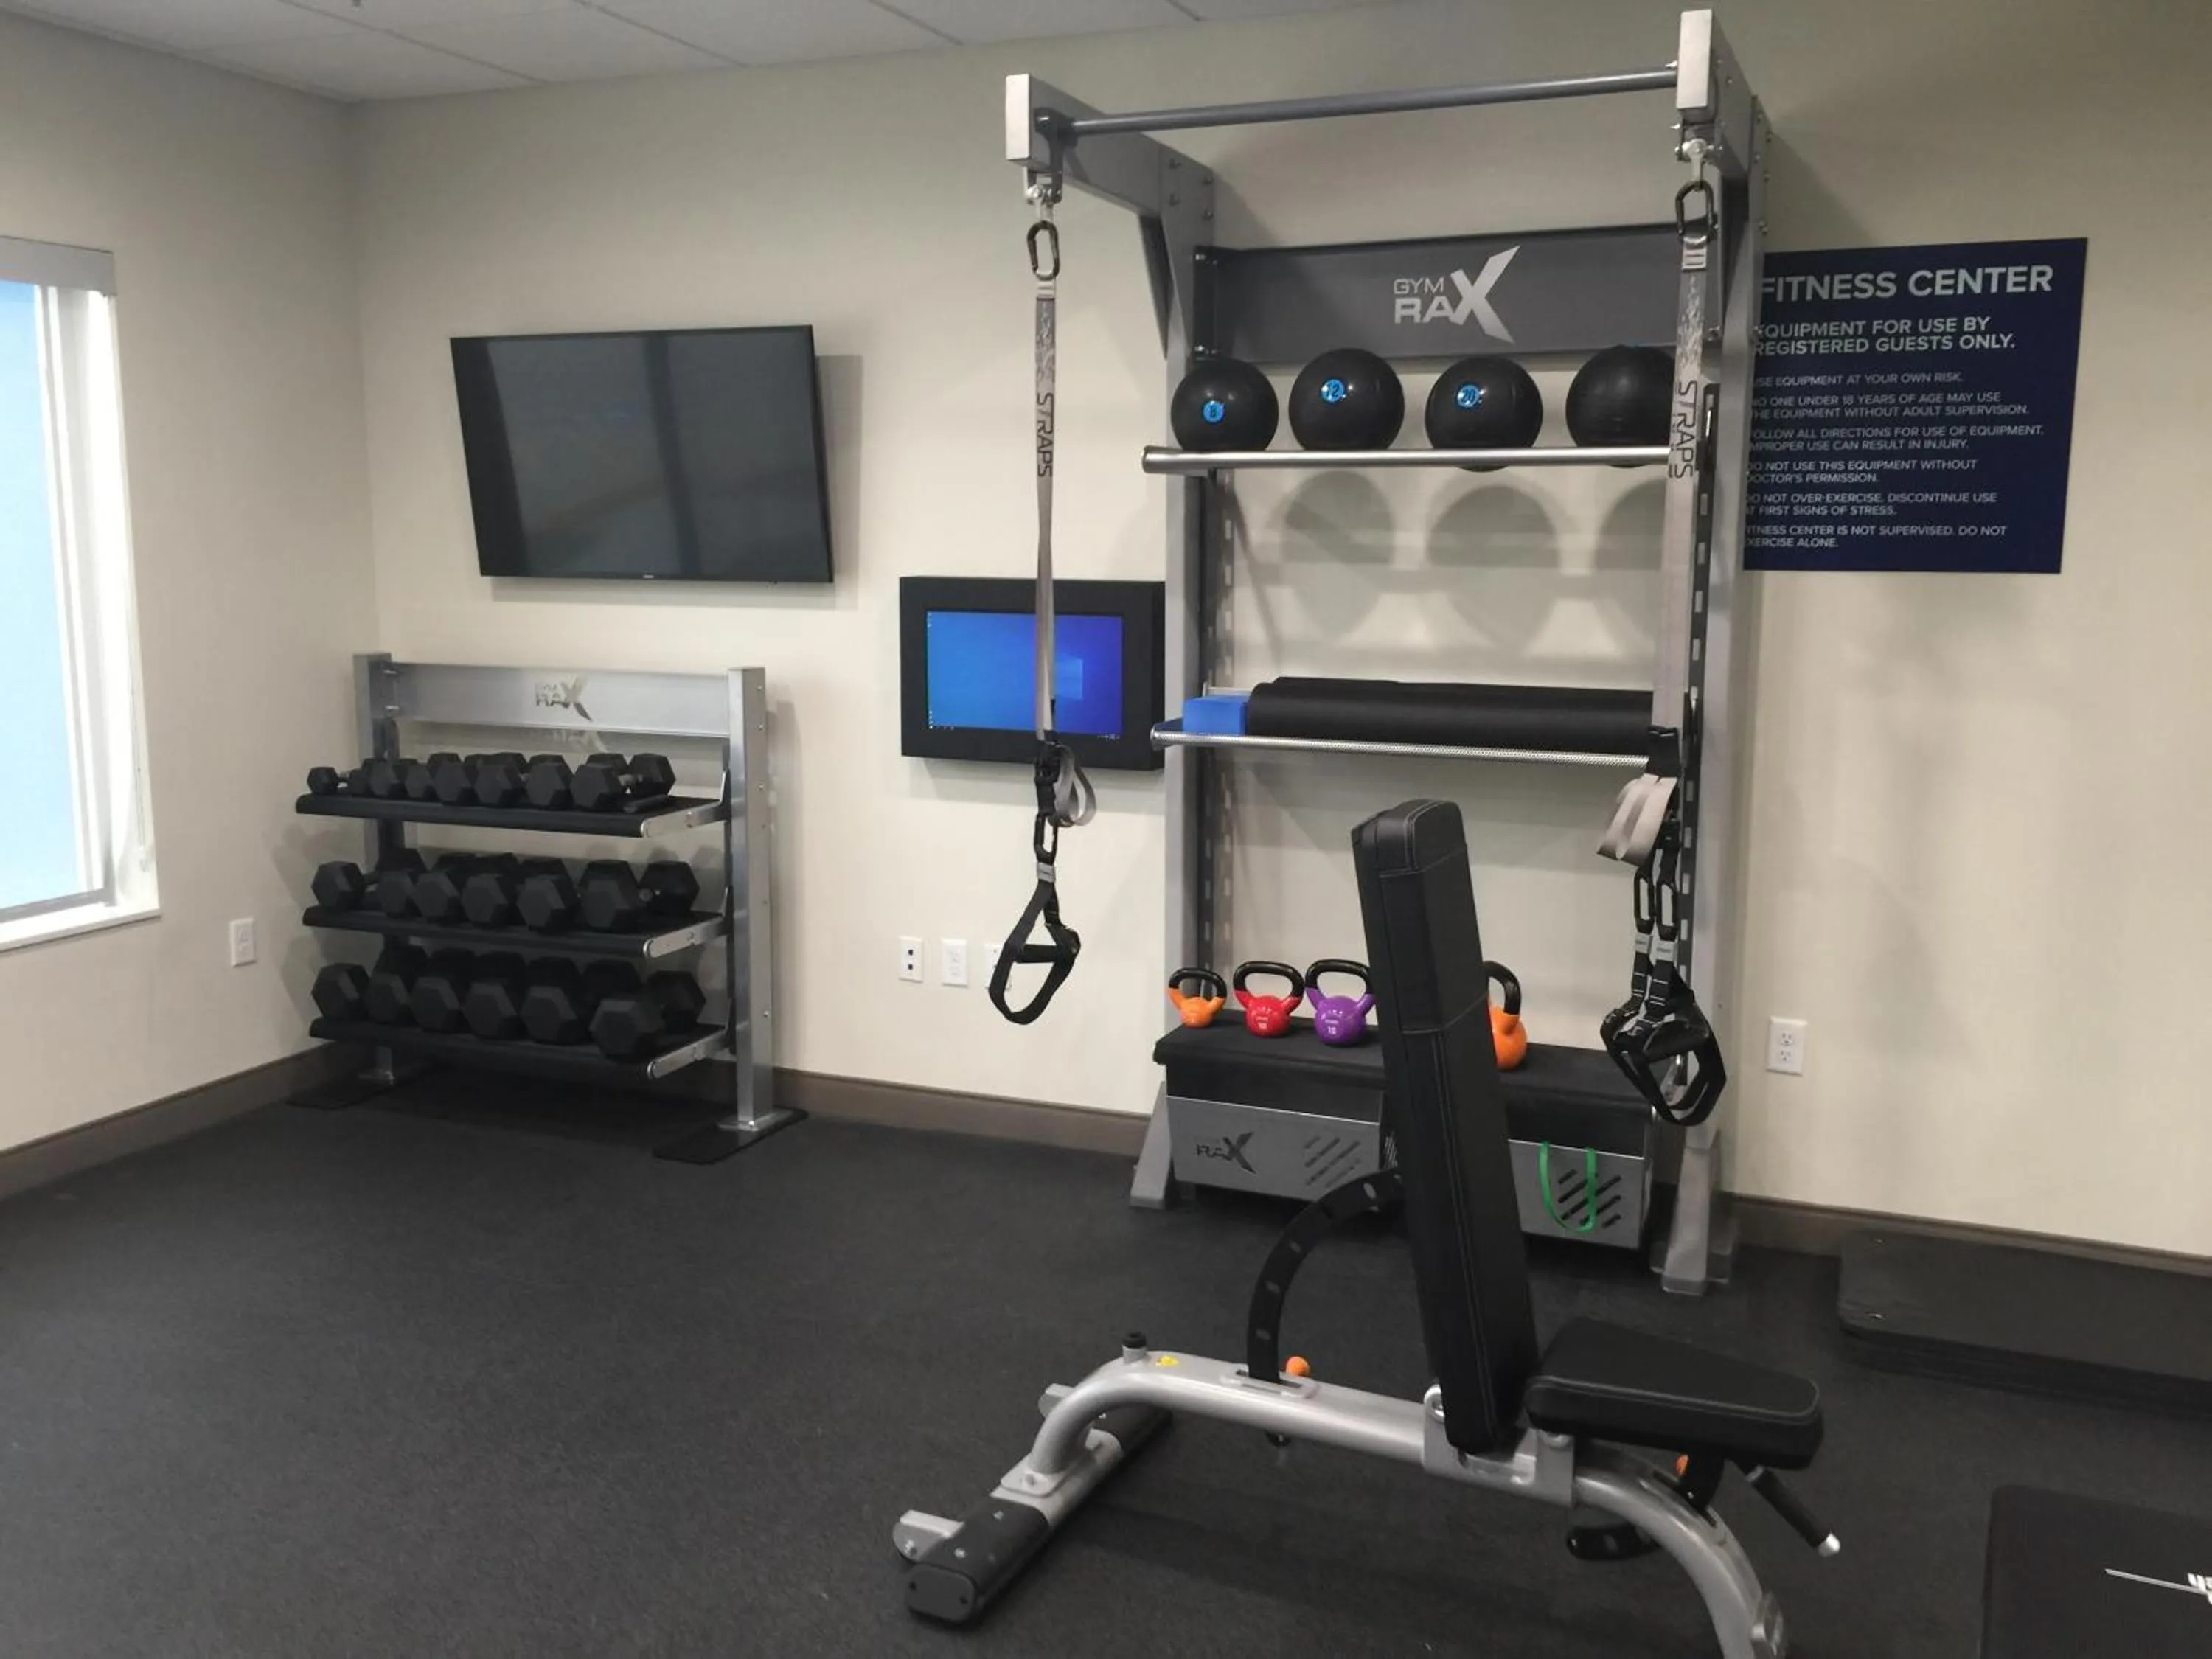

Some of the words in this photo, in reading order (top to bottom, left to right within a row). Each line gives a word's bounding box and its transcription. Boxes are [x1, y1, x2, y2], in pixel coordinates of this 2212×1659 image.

[1394, 276, 1444, 295] GYM
[1908, 265, 2053, 296] CENTER
[1873, 319, 1912, 335] FOR
[1919, 318, 1958, 333] USE
[1964, 316, 1991, 332] BY
[1876, 335, 1953, 351] GUESTS
[1959, 333, 2015, 349] ONLY.
[1756, 377, 1773, 386] SE
[1775, 375, 1843, 386] EQUIPMENT
[1846, 374, 1861, 384] AT
[1865, 373, 1898, 383] YOUR
[1901, 372, 1931, 383] OWN
[1770, 397, 1795, 406] ONE
[1798, 395, 1838, 406] UNDER
[1857, 394, 1896, 405] YEARS
[1899, 394, 1916, 403] OF
[1919, 393, 1944, 403] AGE
[1947, 392, 1974, 402] MAY
[1977, 392, 2001, 402] USE
[1755, 409, 1770, 420] HE
[1773, 408, 1841, 419] EQUIPMENT
[1844, 406, 1900, 417] WITHOUT
[1903, 406, 1942, 416] ADULT
[1945, 404, 2029, 415] SUPERVISION.
[1036, 393, 1054, 477] STRAPS
[1674, 380, 1698, 478] STRAPS
[1753, 429, 1795, 439] OLLOW
[1797, 428, 1817, 439] ALL
[1820, 428, 1891, 439] DIRECTIONS
[1894, 427, 1919, 437] FOR
[1921, 426, 1945, 437] USE
[1949, 425, 1967, 437] OF
[1969, 425, 2044, 436] EQUIPMENT.
[1751, 441, 1804, 451] MPROPER
[1806, 441, 1830, 451] USE
[1832, 440, 1859, 451] CAN
[1862, 439, 1905, 450] RESULT
[1907, 439, 1921, 449] IN
[1924, 439, 1969, 449] INJURY.
[1765, 461, 1790, 470] NOT
[1793, 461, 1816, 470] USE
[1819, 461, 1846, 471] THIS
[1848, 460, 1918, 470] EQUIPMENT
[1920, 459, 1978, 470] WITHOUT
[1763, 493, 1789, 503] NOT
[1888, 493, 1971, 503] DISCONTINUE
[1972, 492, 1997, 502] USE
[1759, 505, 1791, 515] FIRST
[1792, 505, 1829, 515] SIGNS
[1831, 505, 1848, 515] OF
[1850, 505, 1898, 515] STRESS.
[1747, 526, 1787, 535] ITNESS
[1789, 525, 1835, 535] CENTER
[1837, 525, 1848, 535] IS
[1850, 525, 1876, 535] NOT
[1958, 526, 1978, 535] DO
[1980, 526, 2008, 535] NOT
[1747, 537, 1795, 547] XERCISE
